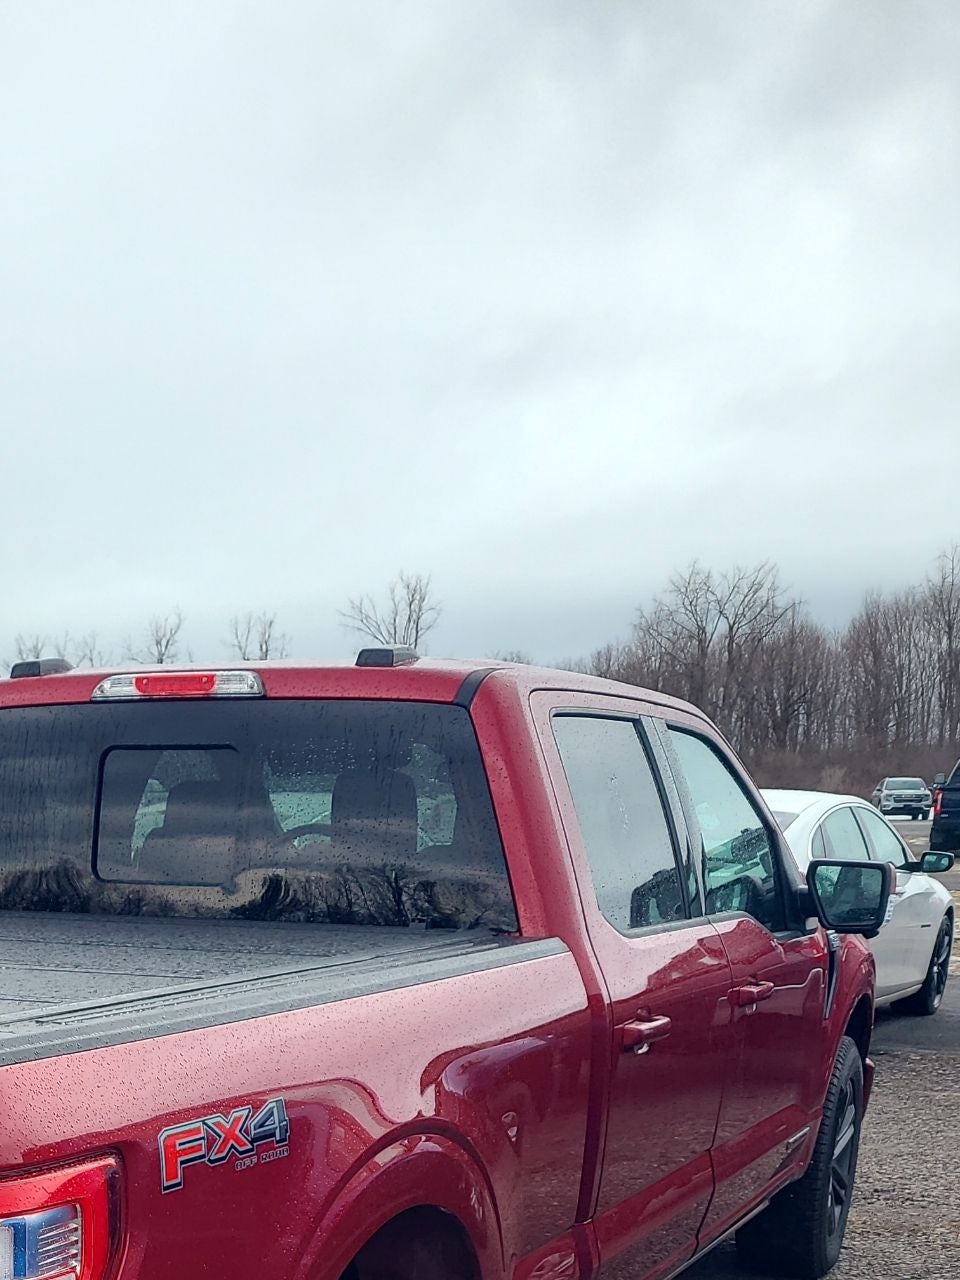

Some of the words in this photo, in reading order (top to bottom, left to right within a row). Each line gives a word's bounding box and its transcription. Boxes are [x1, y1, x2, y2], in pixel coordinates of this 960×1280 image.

[157, 1096, 291, 1195] FX4
[235, 1156, 258, 1171] OFF
[261, 1147, 289, 1163] ROAD
